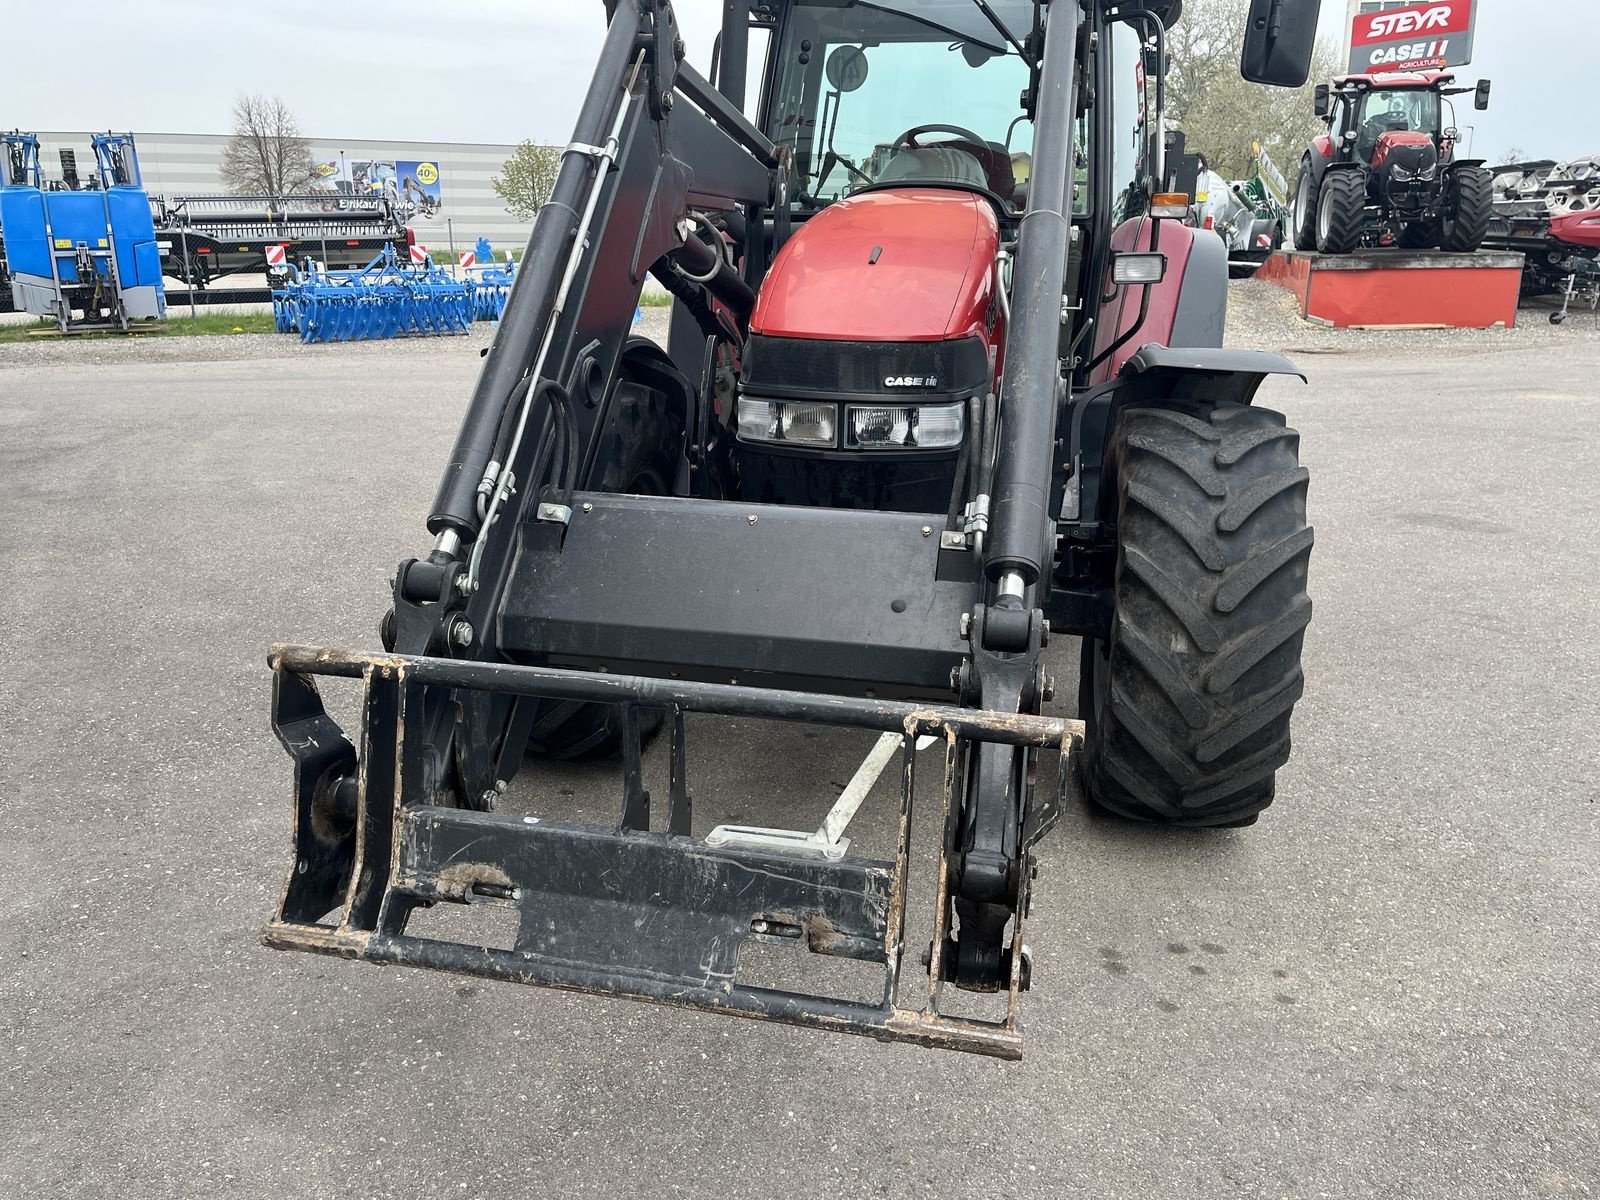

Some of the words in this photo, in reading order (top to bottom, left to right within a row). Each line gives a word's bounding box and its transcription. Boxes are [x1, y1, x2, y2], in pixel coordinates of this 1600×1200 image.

[1367, 5, 1451, 38] STEYR
[1369, 42, 1426, 65] CASE
[1398, 58, 1440, 69] AGRICULTURE
[417, 169, 437, 177] 40%
[395, 200, 415, 210] wie
[884, 376, 923, 387] CASE
